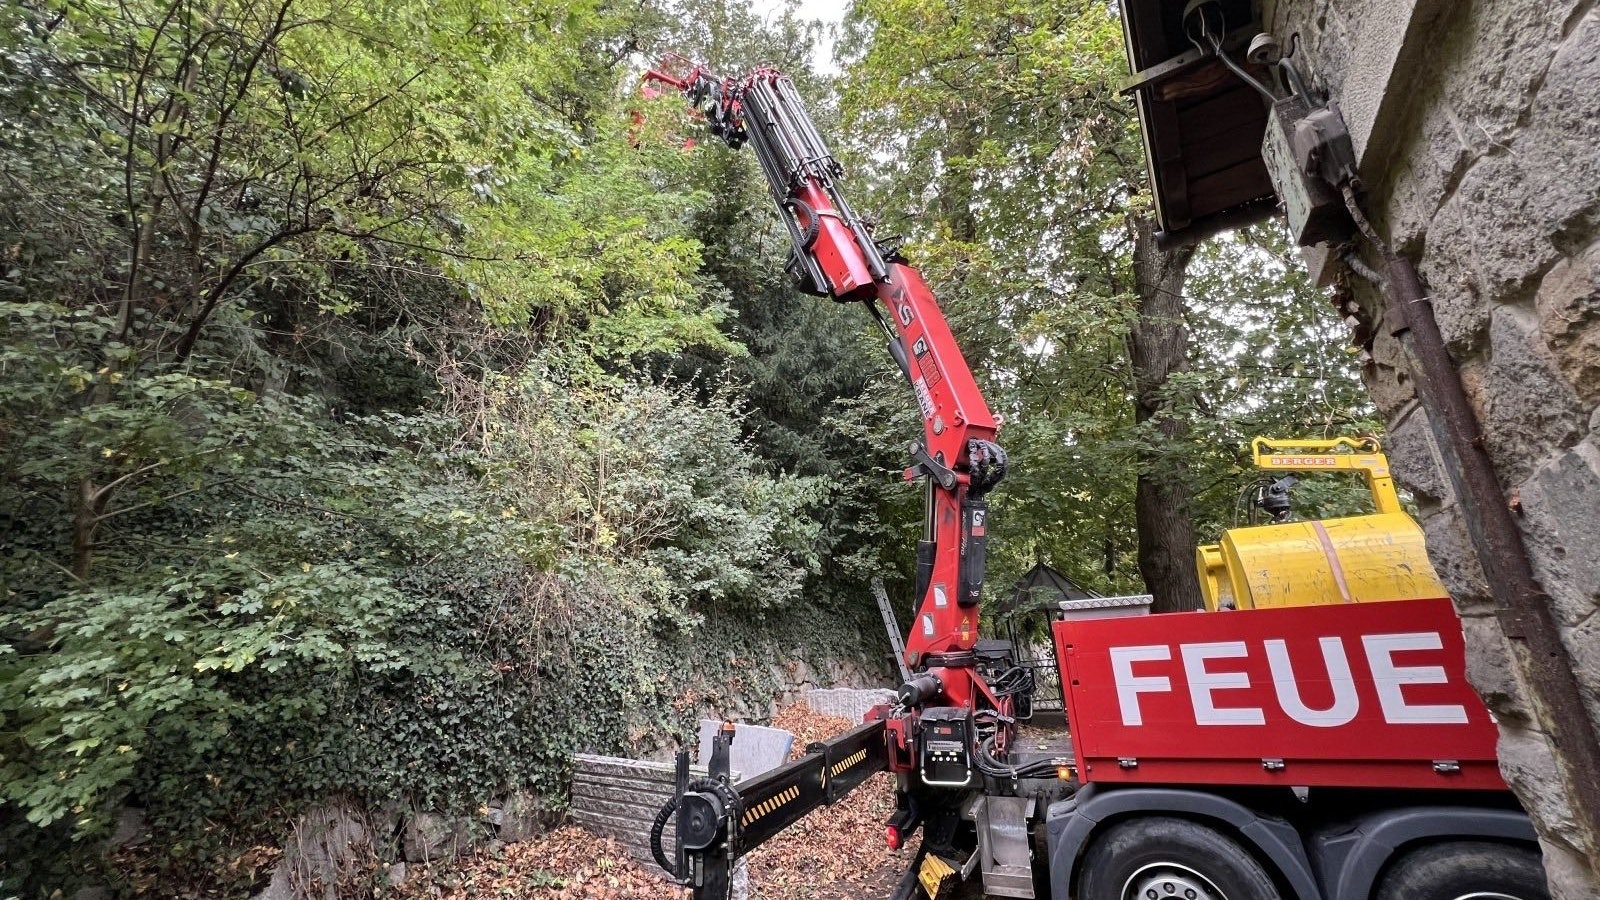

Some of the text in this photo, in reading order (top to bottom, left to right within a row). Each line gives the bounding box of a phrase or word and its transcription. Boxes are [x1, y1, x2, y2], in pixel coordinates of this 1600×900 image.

[914, 382, 931, 418] KRANE
[1271, 457, 1336, 466] BERGER
[1109, 632, 1498, 728] FEUE
